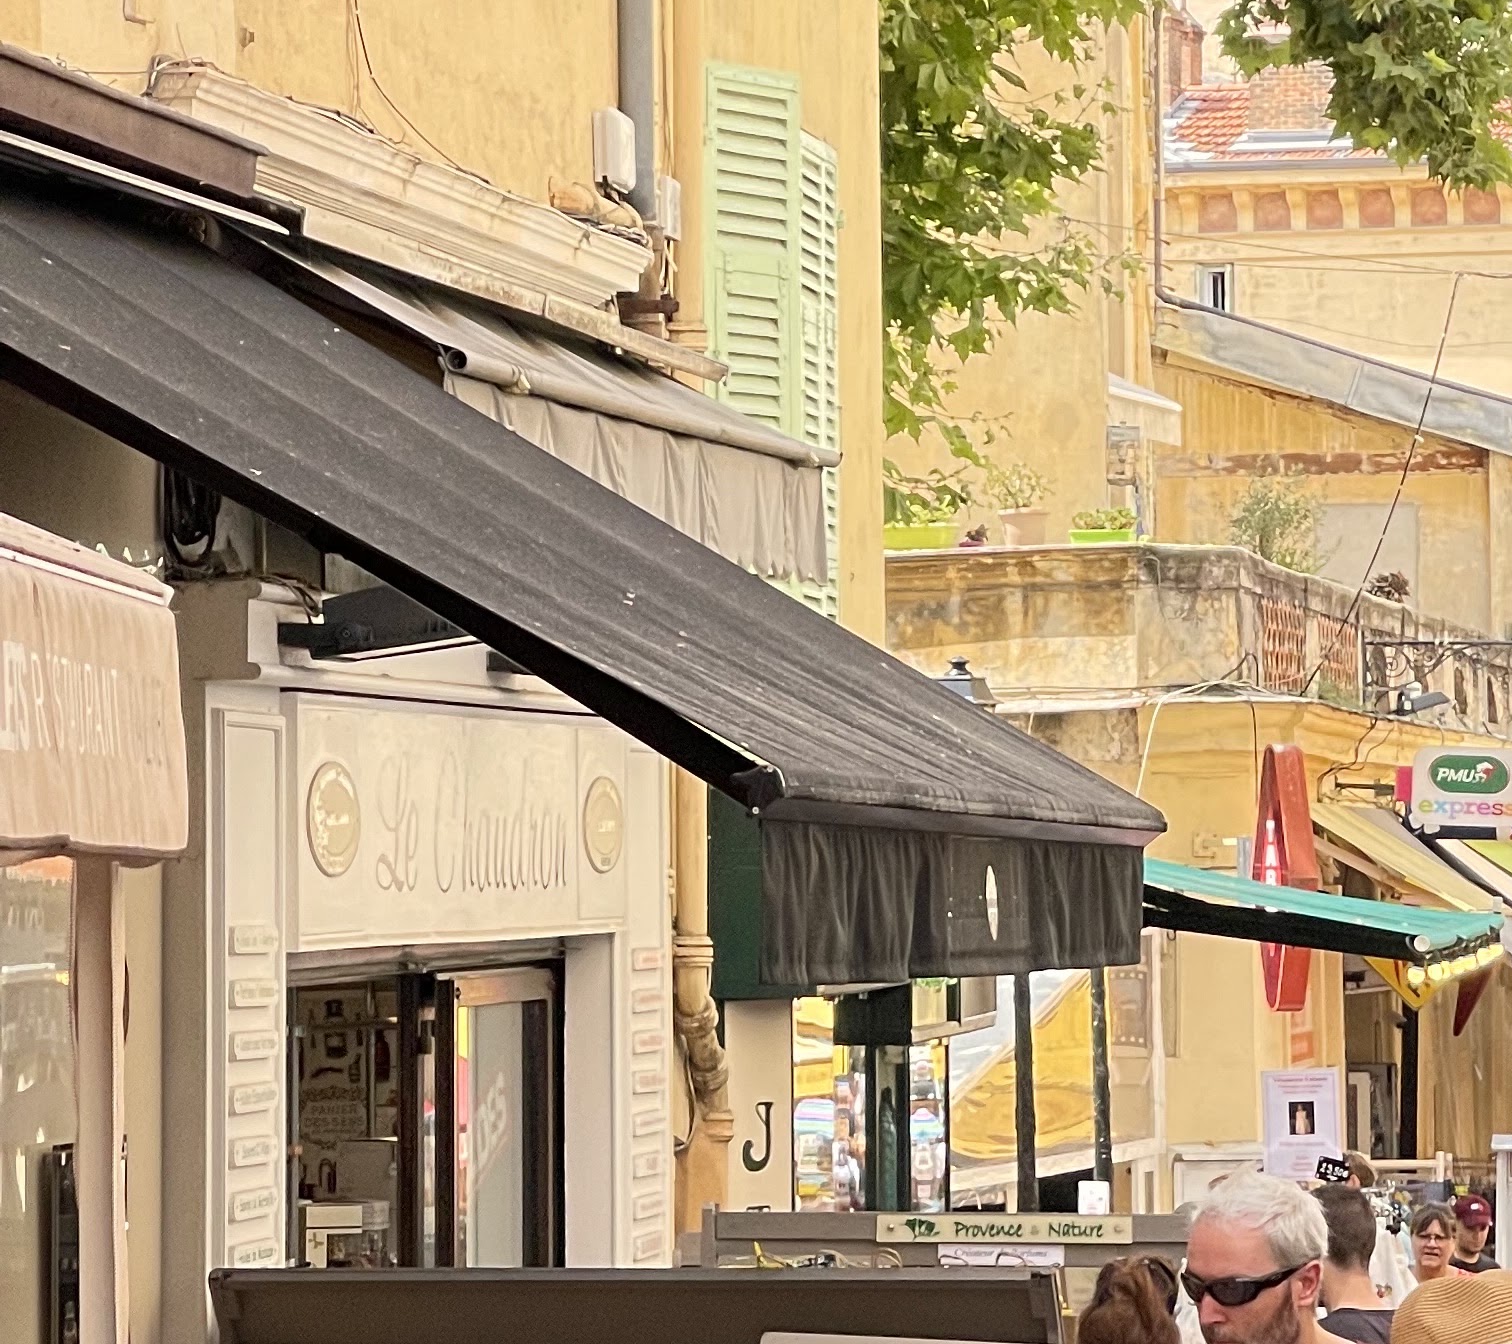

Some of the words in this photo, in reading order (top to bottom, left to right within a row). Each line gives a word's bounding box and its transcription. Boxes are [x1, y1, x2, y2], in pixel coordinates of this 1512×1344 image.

[1437, 767, 1473, 783] PMU
[376, 752, 418, 892] Le
[434, 748, 567, 893] Chaudron
[954, 1221, 1023, 1238] Provence
[1049, 1221, 1104, 1237] Nature
